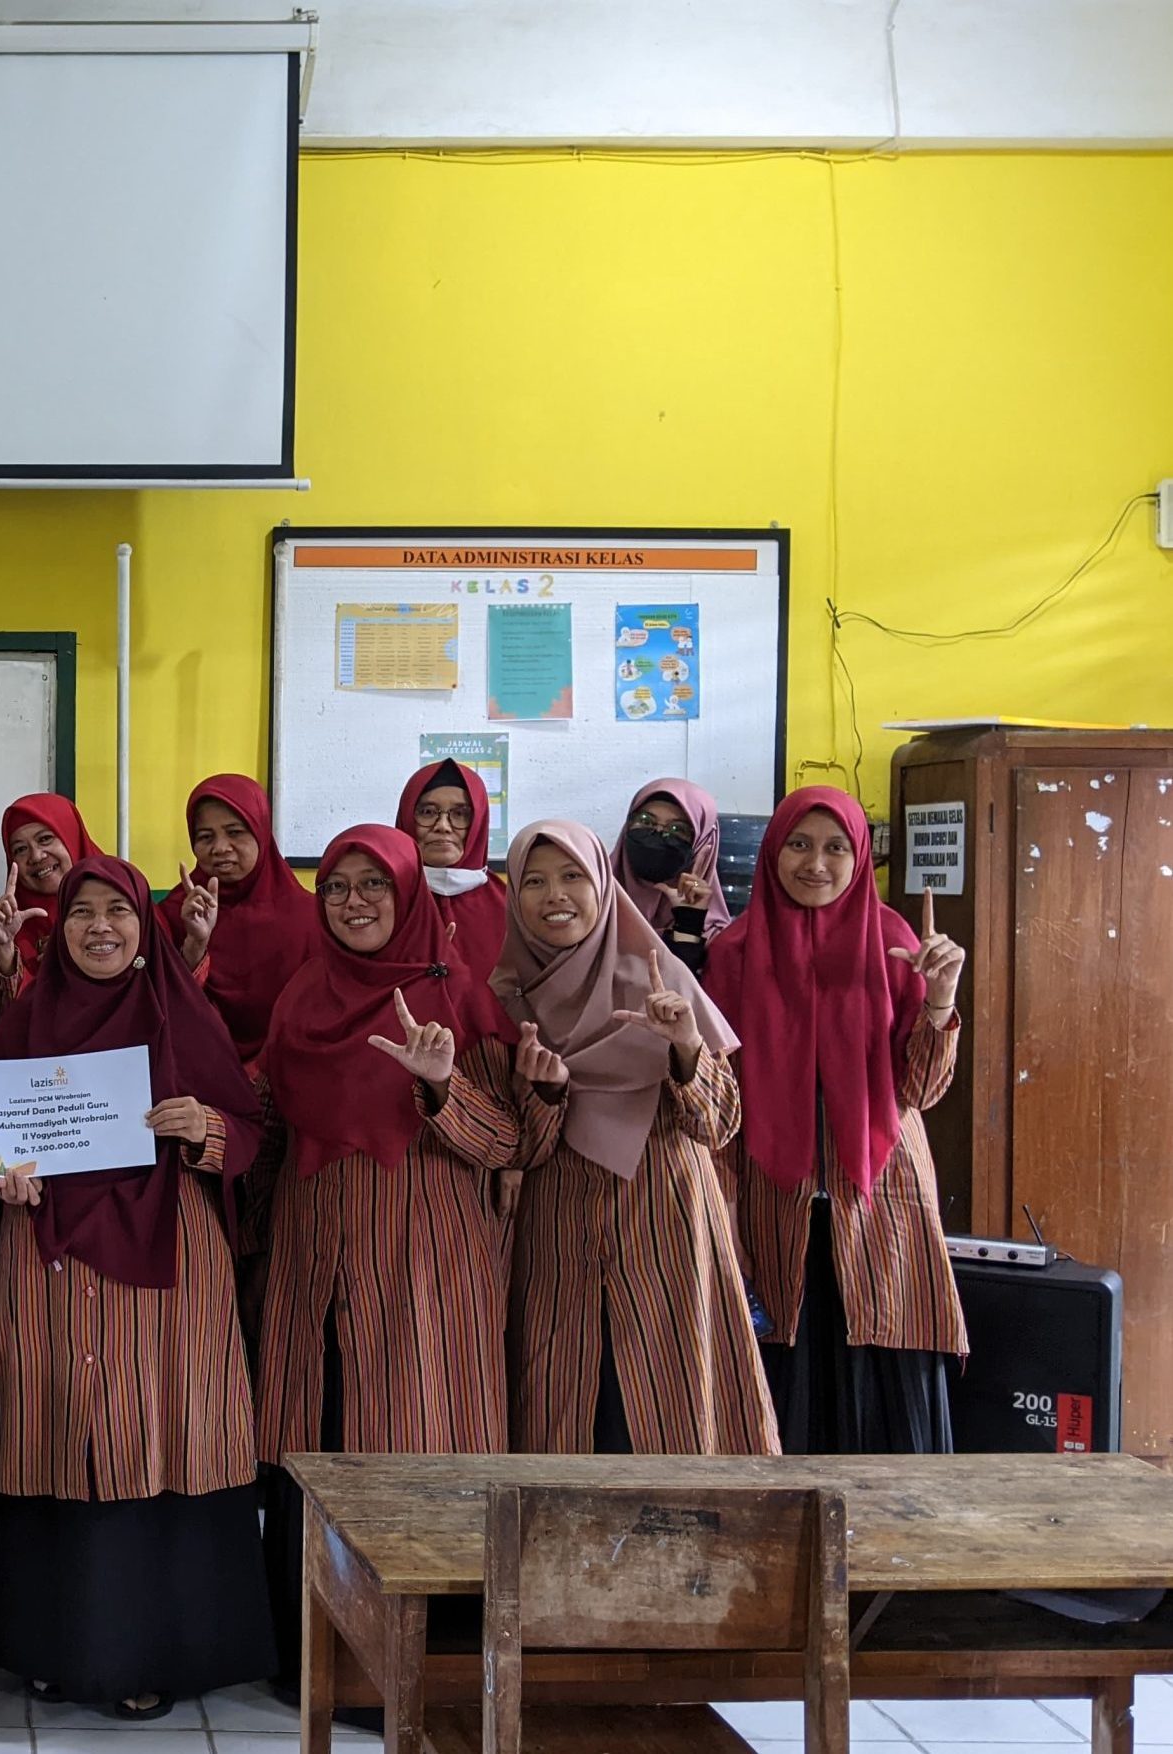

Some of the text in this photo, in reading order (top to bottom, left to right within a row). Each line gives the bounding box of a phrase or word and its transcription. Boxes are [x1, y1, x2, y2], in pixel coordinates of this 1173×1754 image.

[402, 551, 644, 565] DATA ADMINISTRASI KELAS
[451, 574, 555, 598] KELAS 2
[30, 1076, 69, 1089] lazismu
[9, 1096, 37, 1104] Lazismu
[54, 1092, 91, 1101] Wirobrajan
[32, 1106, 56, 1116] Dana
[58, 1103, 85, 1113] Peduli
[87, 1101, 109, 1110] Guru
[70, 1112, 119, 1125] Wirobrajan
[30, 1128, 81, 1141] Yogyakarta
[14, 1140, 91, 1156] Rp. 7.500.000,00
[1012, 1392, 1052, 1412] 200
[1026, 1414, 1058, 1428] GL-15
[1067, 1396, 1083, 1437] Huper
